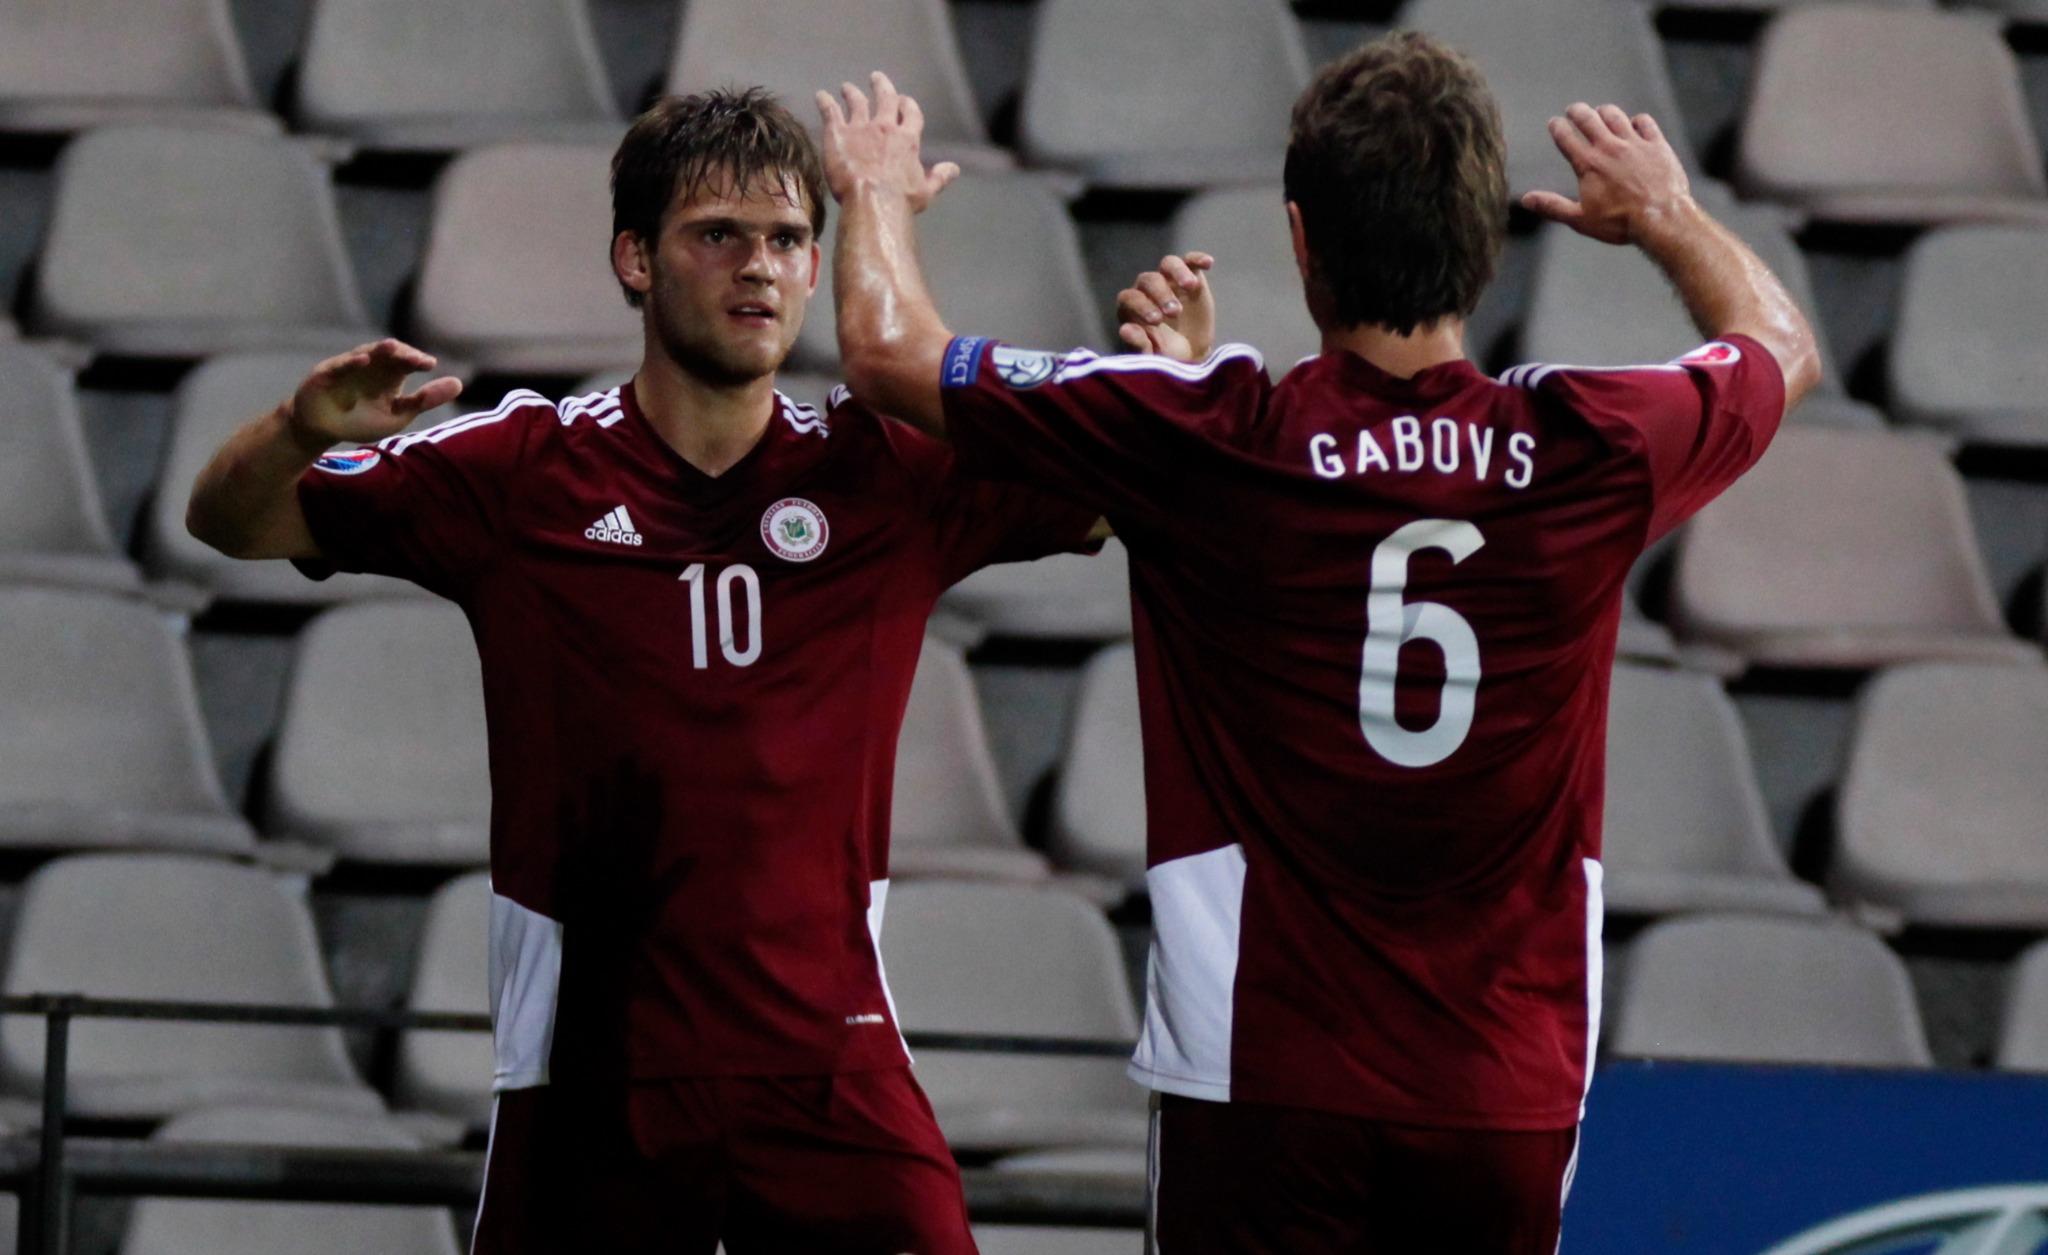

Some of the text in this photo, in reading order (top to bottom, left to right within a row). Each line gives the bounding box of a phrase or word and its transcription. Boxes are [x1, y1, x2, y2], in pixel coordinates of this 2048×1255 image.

[1309, 415, 1536, 489] GABOVS
[584, 527, 643, 546] adidas
[678, 563, 762, 669] 10
[1359, 518, 1486, 768] 6
